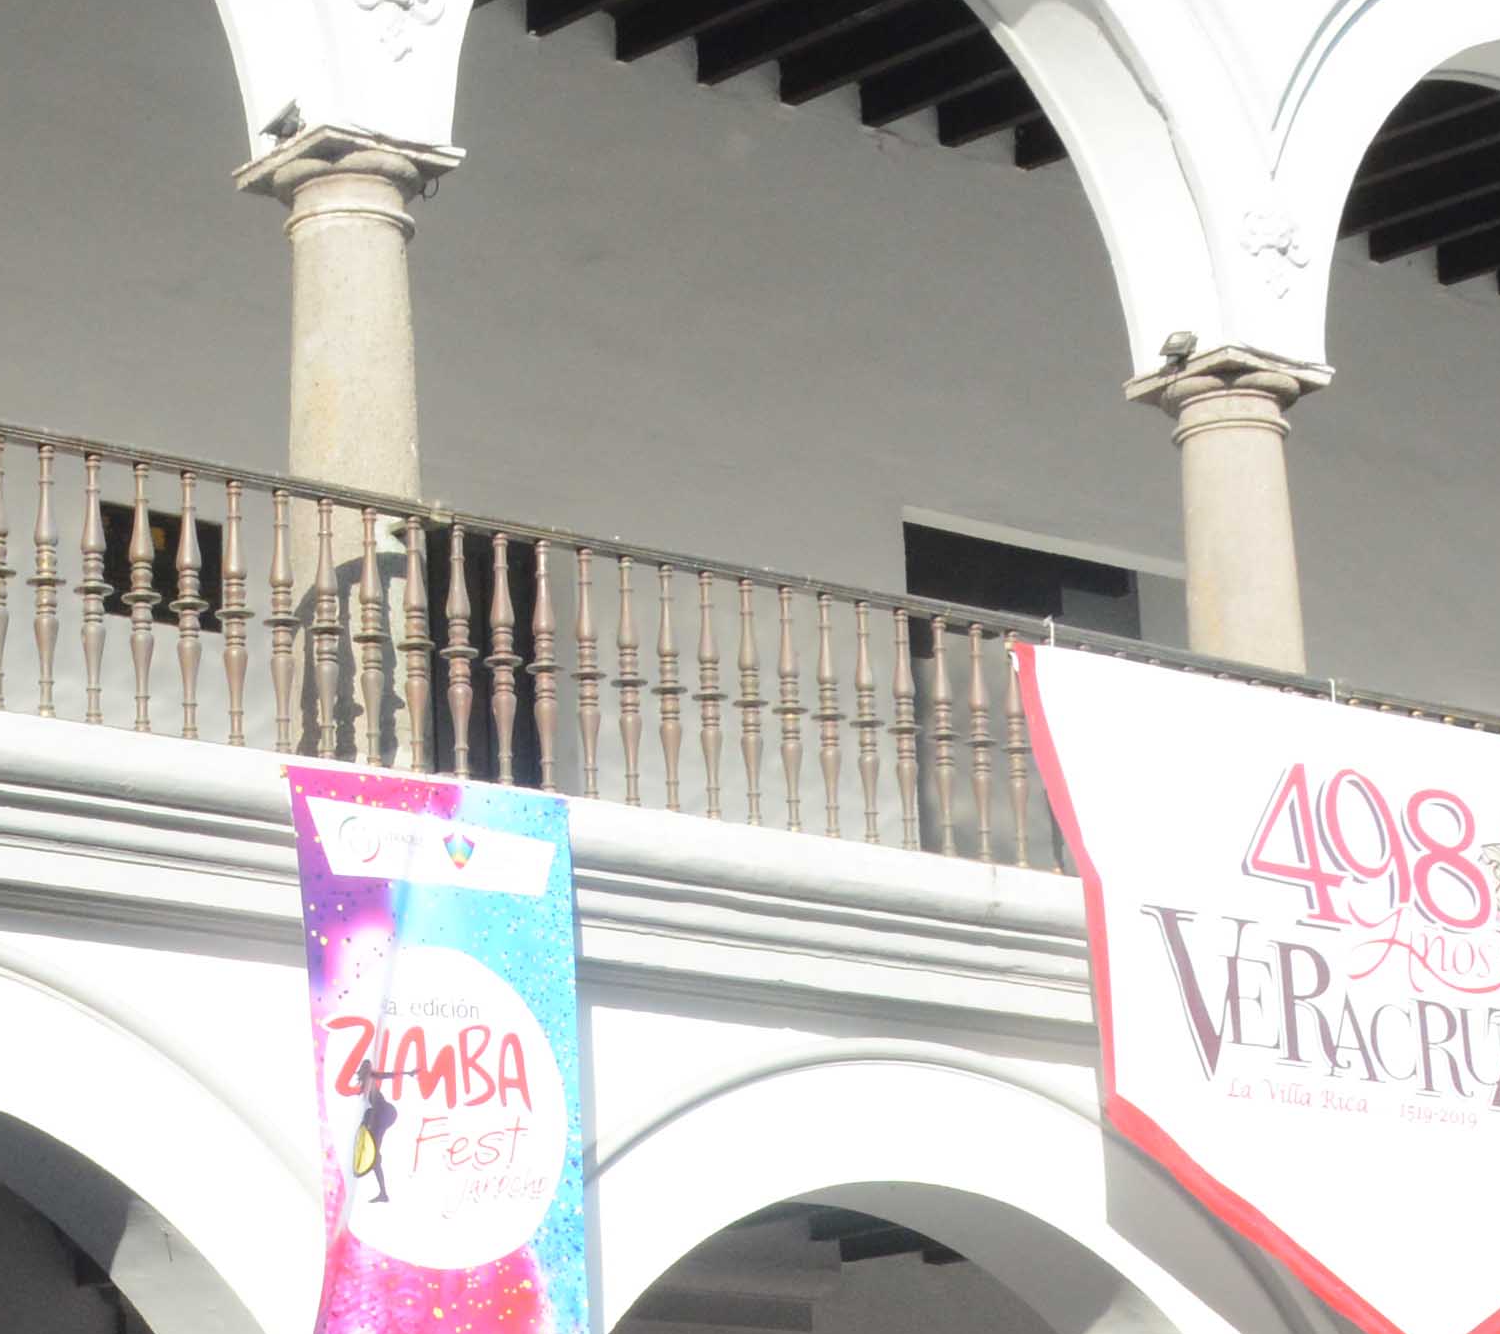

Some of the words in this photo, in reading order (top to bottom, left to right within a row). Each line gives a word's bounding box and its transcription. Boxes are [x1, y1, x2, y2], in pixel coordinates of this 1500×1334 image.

[1243, 763, 1491, 933] 498
[408, 995, 480, 1020] edición
[326, 1016, 533, 1113] ZIMBA
[1227, 1077, 1253, 1100] La
[1262, 1078, 1312, 1107] Villa
[1320, 1090, 1369, 1115] Rica
[412, 1116, 529, 1173] Fest
